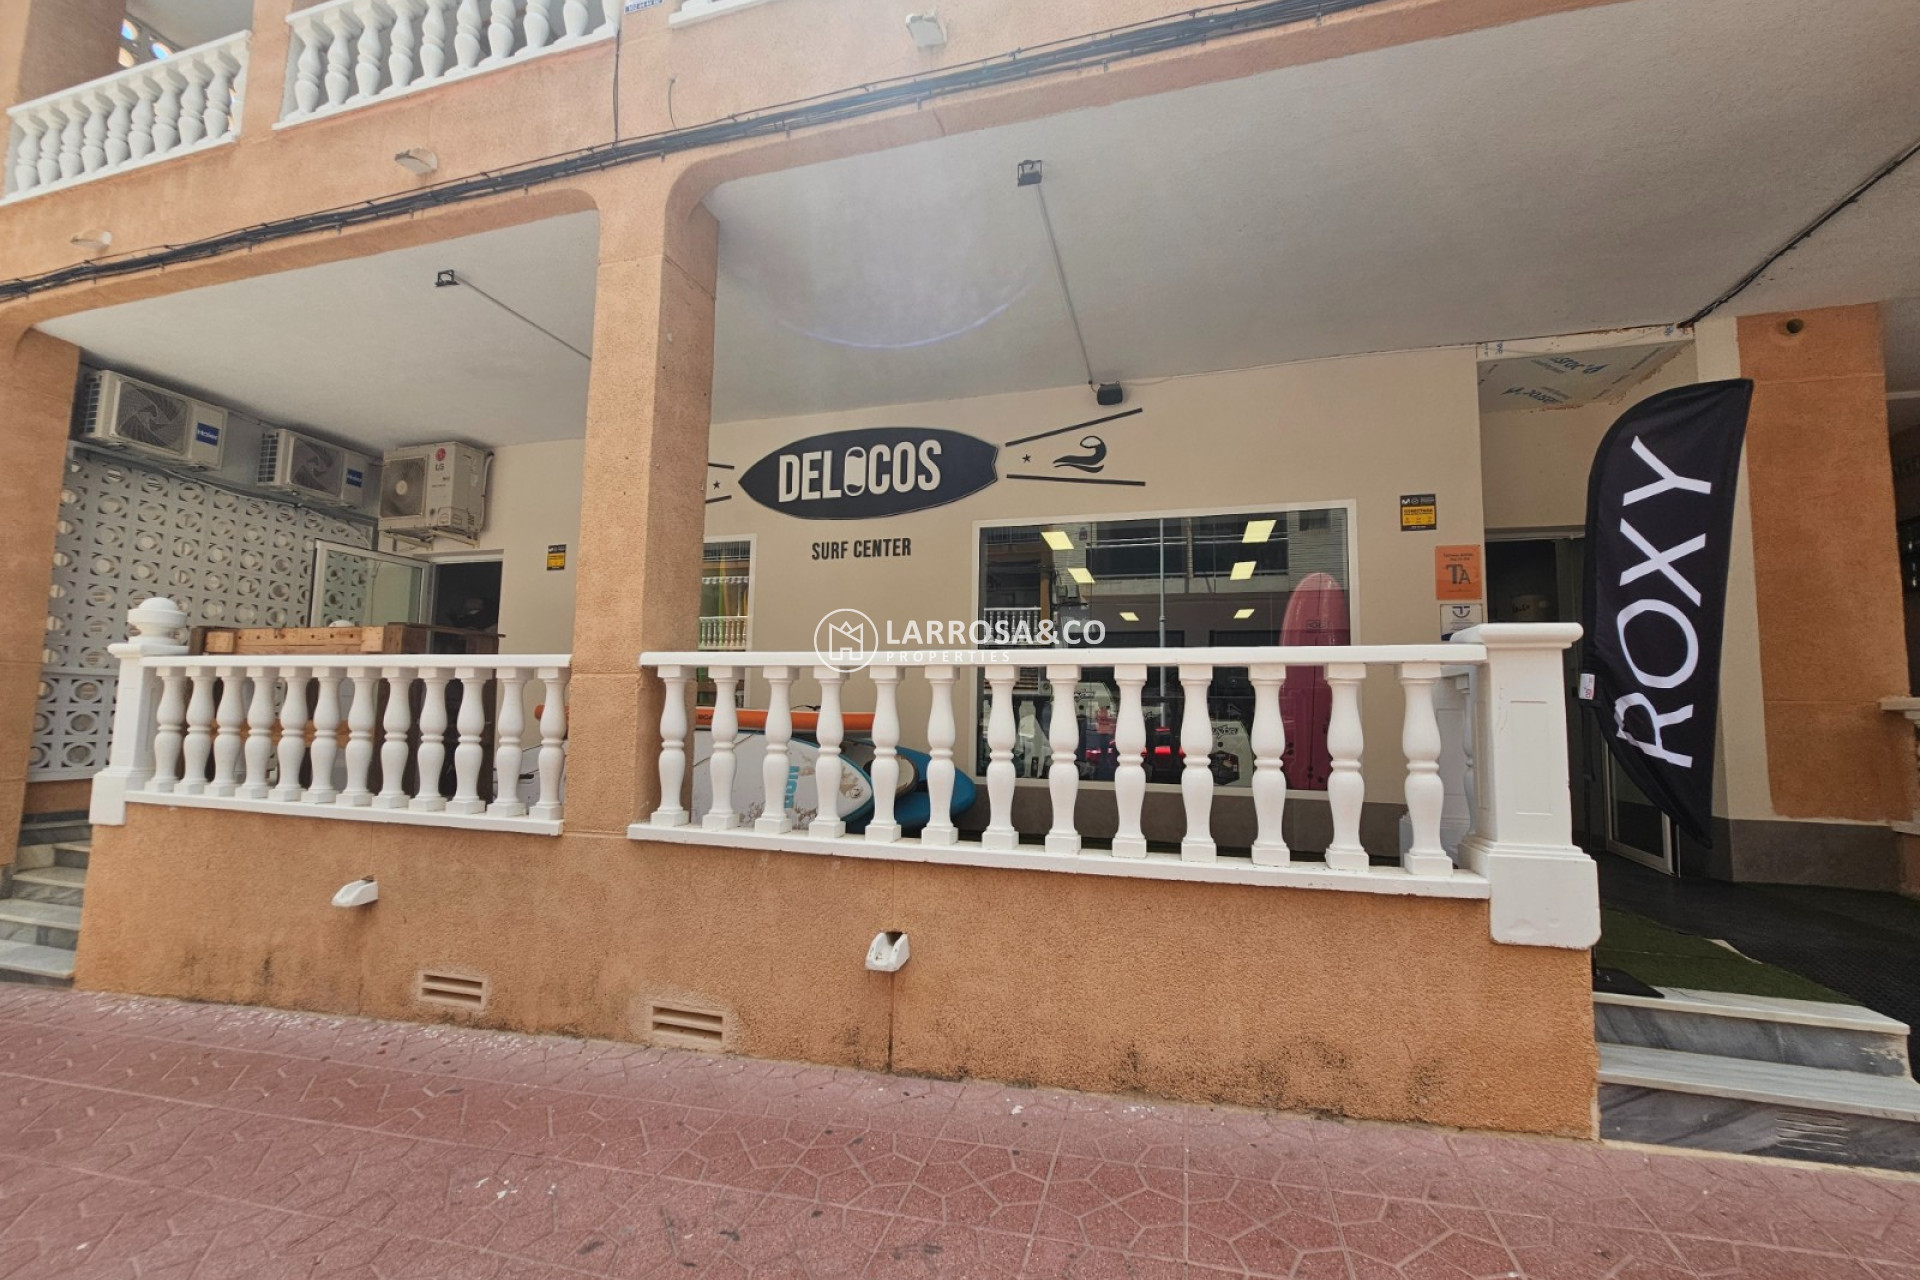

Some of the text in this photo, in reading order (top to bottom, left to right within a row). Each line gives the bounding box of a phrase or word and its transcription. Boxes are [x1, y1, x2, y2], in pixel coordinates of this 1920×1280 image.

[811, 537, 912, 560] SURF CENTER
[1614, 435, 1712, 768] ROXY
